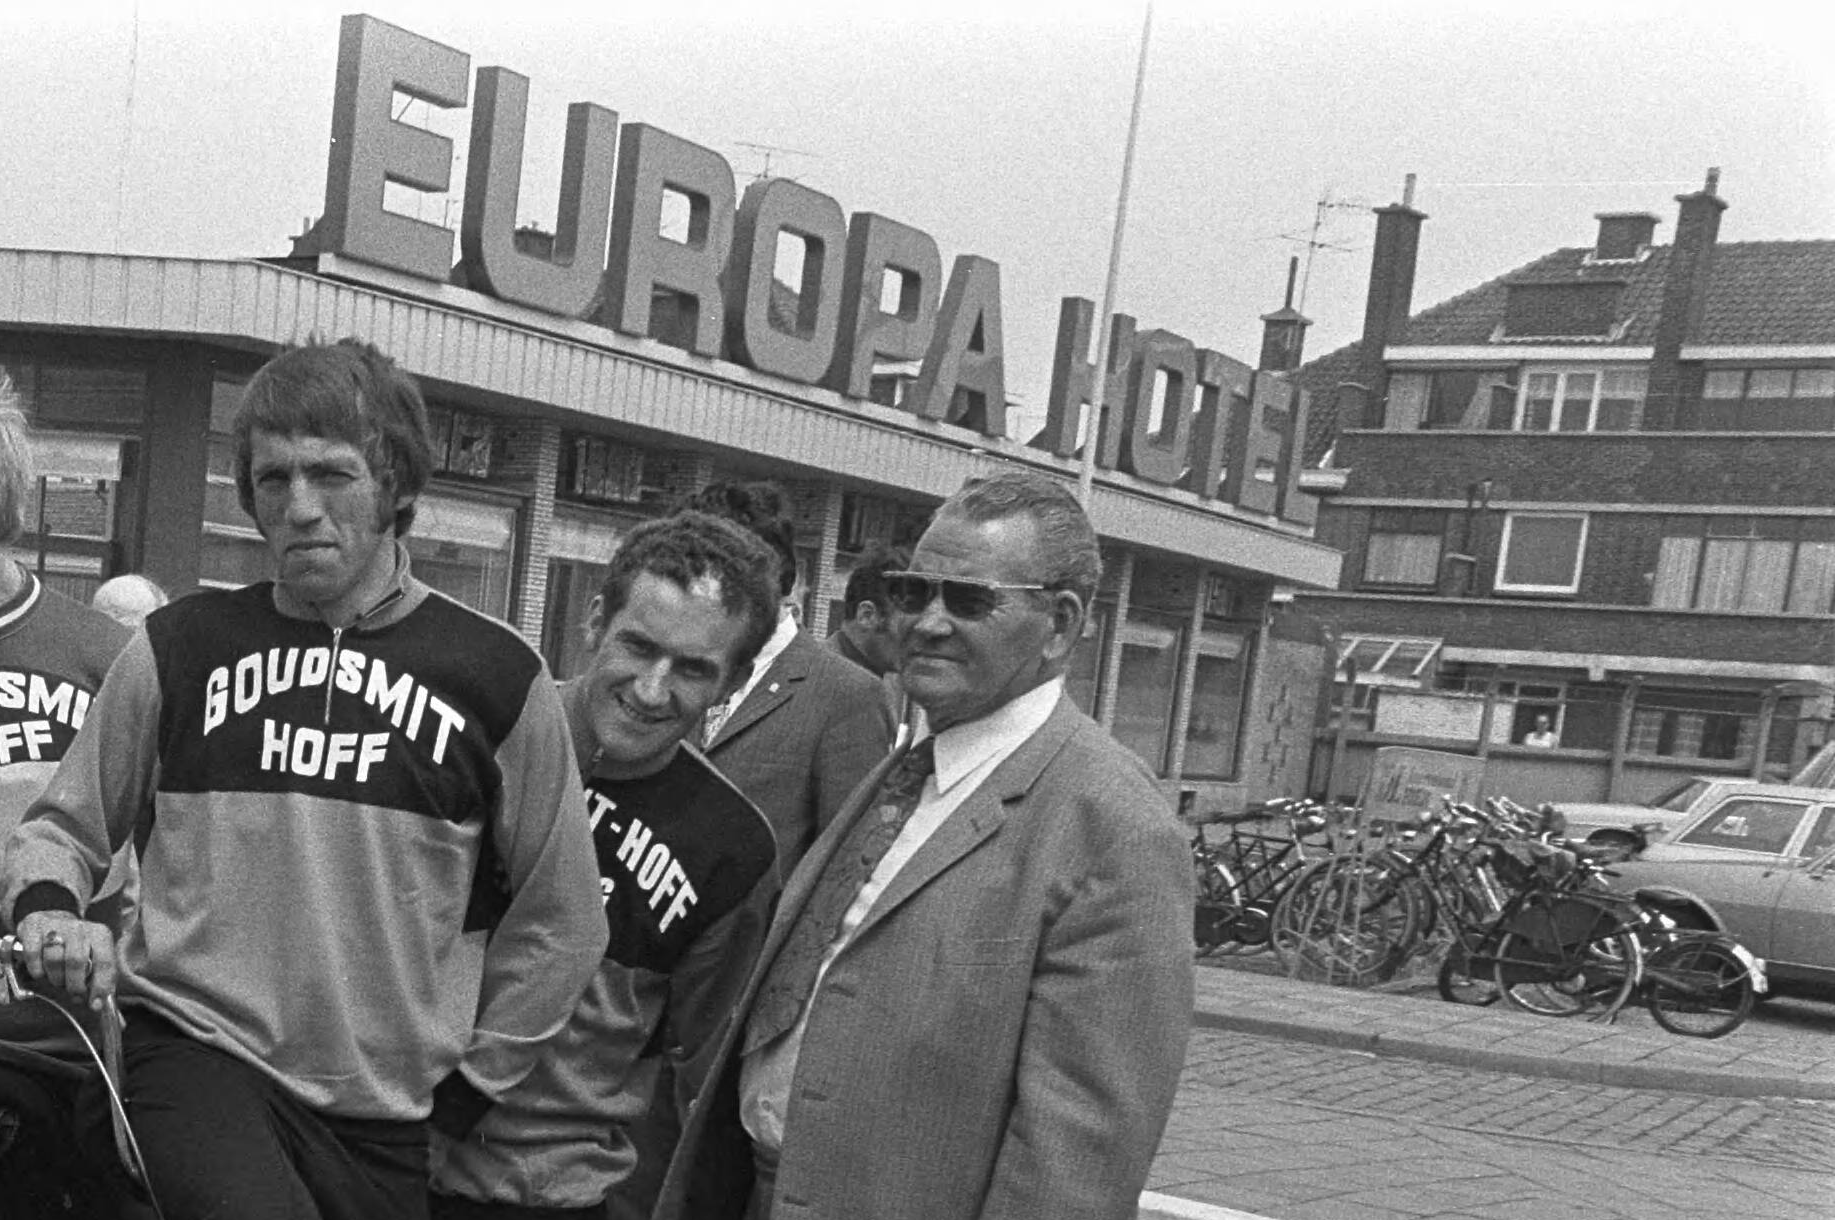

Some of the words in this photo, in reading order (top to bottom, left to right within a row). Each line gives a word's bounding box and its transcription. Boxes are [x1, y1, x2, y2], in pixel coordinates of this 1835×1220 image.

[323, 12, 1006, 438] EUROPA
[1046, 296, 1320, 528] HOTEL
[204, 647, 465, 765] GOUDSMIT
[261, 719, 390, 783] HOFF
